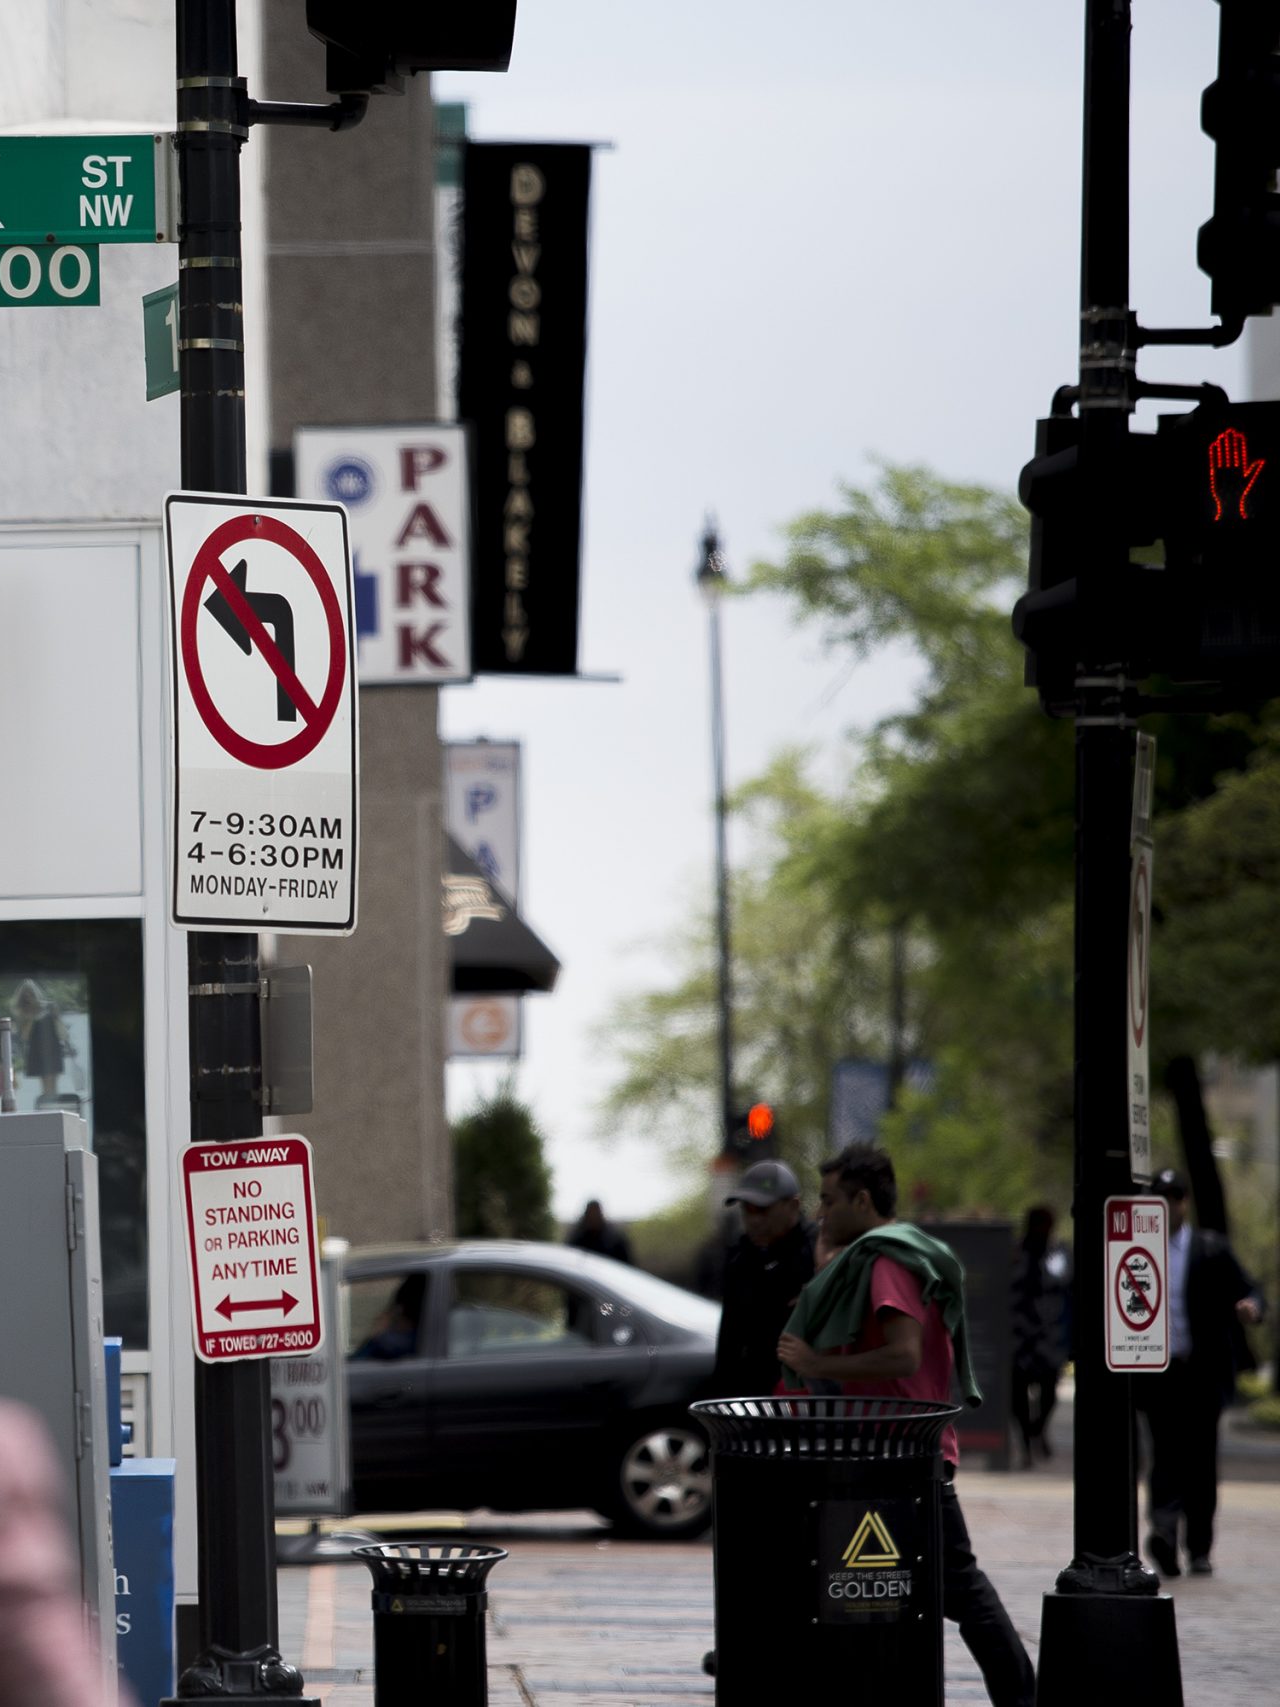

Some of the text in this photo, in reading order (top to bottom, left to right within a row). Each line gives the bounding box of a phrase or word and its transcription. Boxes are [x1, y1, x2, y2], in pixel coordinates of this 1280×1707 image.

[81, 154, 133, 189] ST
[79, 194, 134, 227] NW
[395, 443, 452, 672] PARK
[190, 810, 342, 840] 7-9:30AM
[187, 842, 344, 870] 4-6:30PM
[190, 874, 339, 899] MONDAY-FRIDAY
[200, 1147, 290, 1167] TOW AWAY
[233, 1180, 262, 1199] NO
[205, 1201, 295, 1226] STANDING
[1113, 1211, 1160, 1234] NO IDLING
[205, 1227, 300, 1252] OR PARKING
[211, 1257, 298, 1281] ANYTIME
[205, 1331, 313, 1354] IF TOWED 727-5000
[828, 1570, 911, 1581] KEEP THE STREETS
[828, 1580, 912, 1599] GOLDEN
